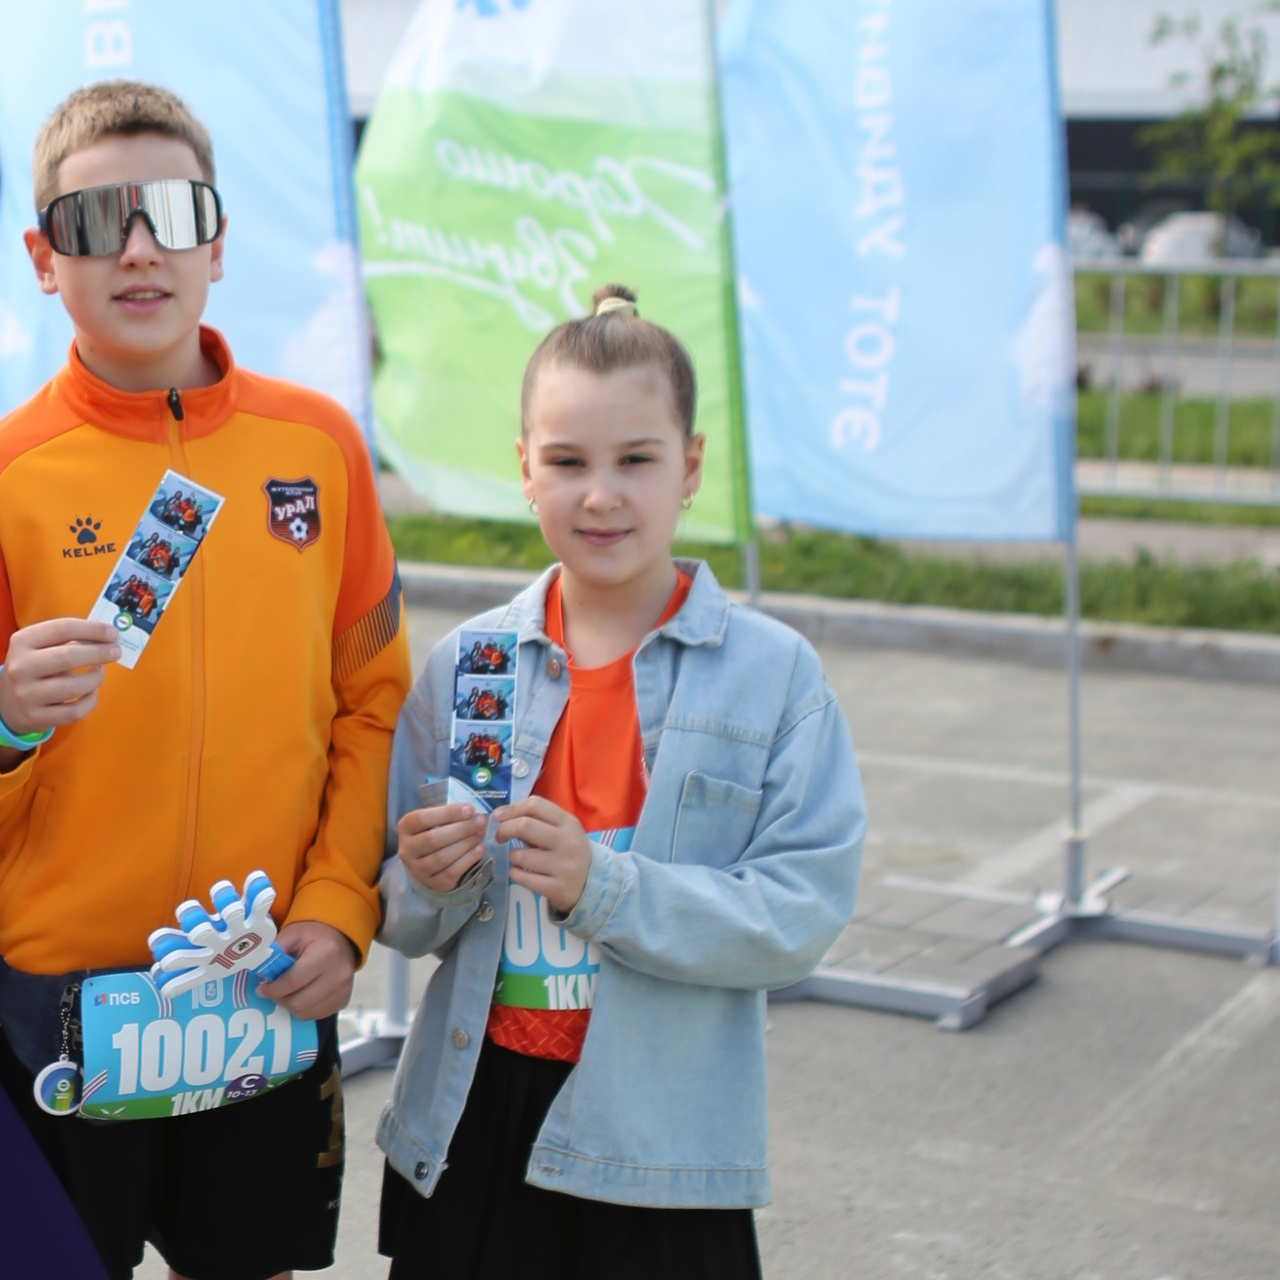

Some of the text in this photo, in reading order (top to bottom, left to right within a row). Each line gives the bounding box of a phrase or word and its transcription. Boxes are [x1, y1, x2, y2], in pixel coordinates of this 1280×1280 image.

[274, 496, 316, 521] УРАЛ
[62, 542, 116, 559] KELME
[109, 992, 141, 1007] ПСБ
[112, 1005, 292, 1096] 10021
